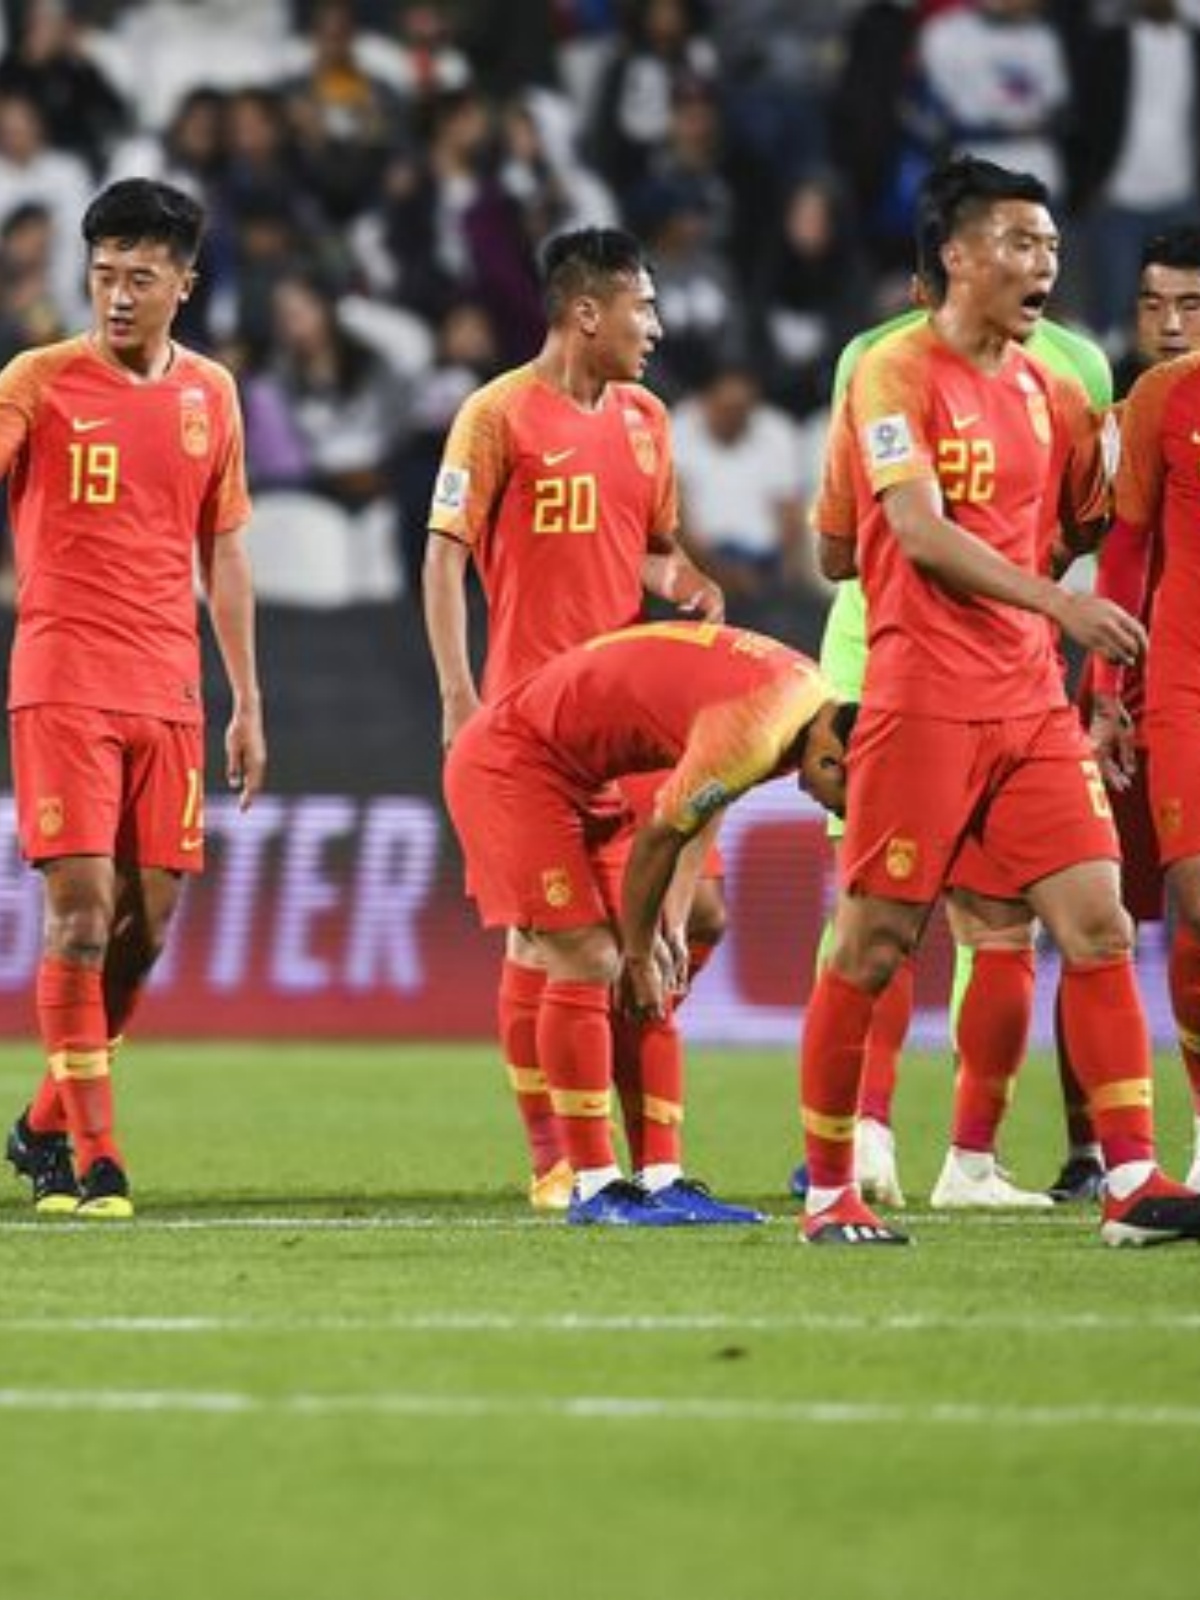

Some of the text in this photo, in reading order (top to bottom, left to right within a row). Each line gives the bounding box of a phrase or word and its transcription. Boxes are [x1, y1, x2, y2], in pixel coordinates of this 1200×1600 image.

[69, 442, 118, 504] 19
[937, 438, 997, 502] 22
[533, 472, 597, 534] 20
[183, 768, 204, 829] 1
